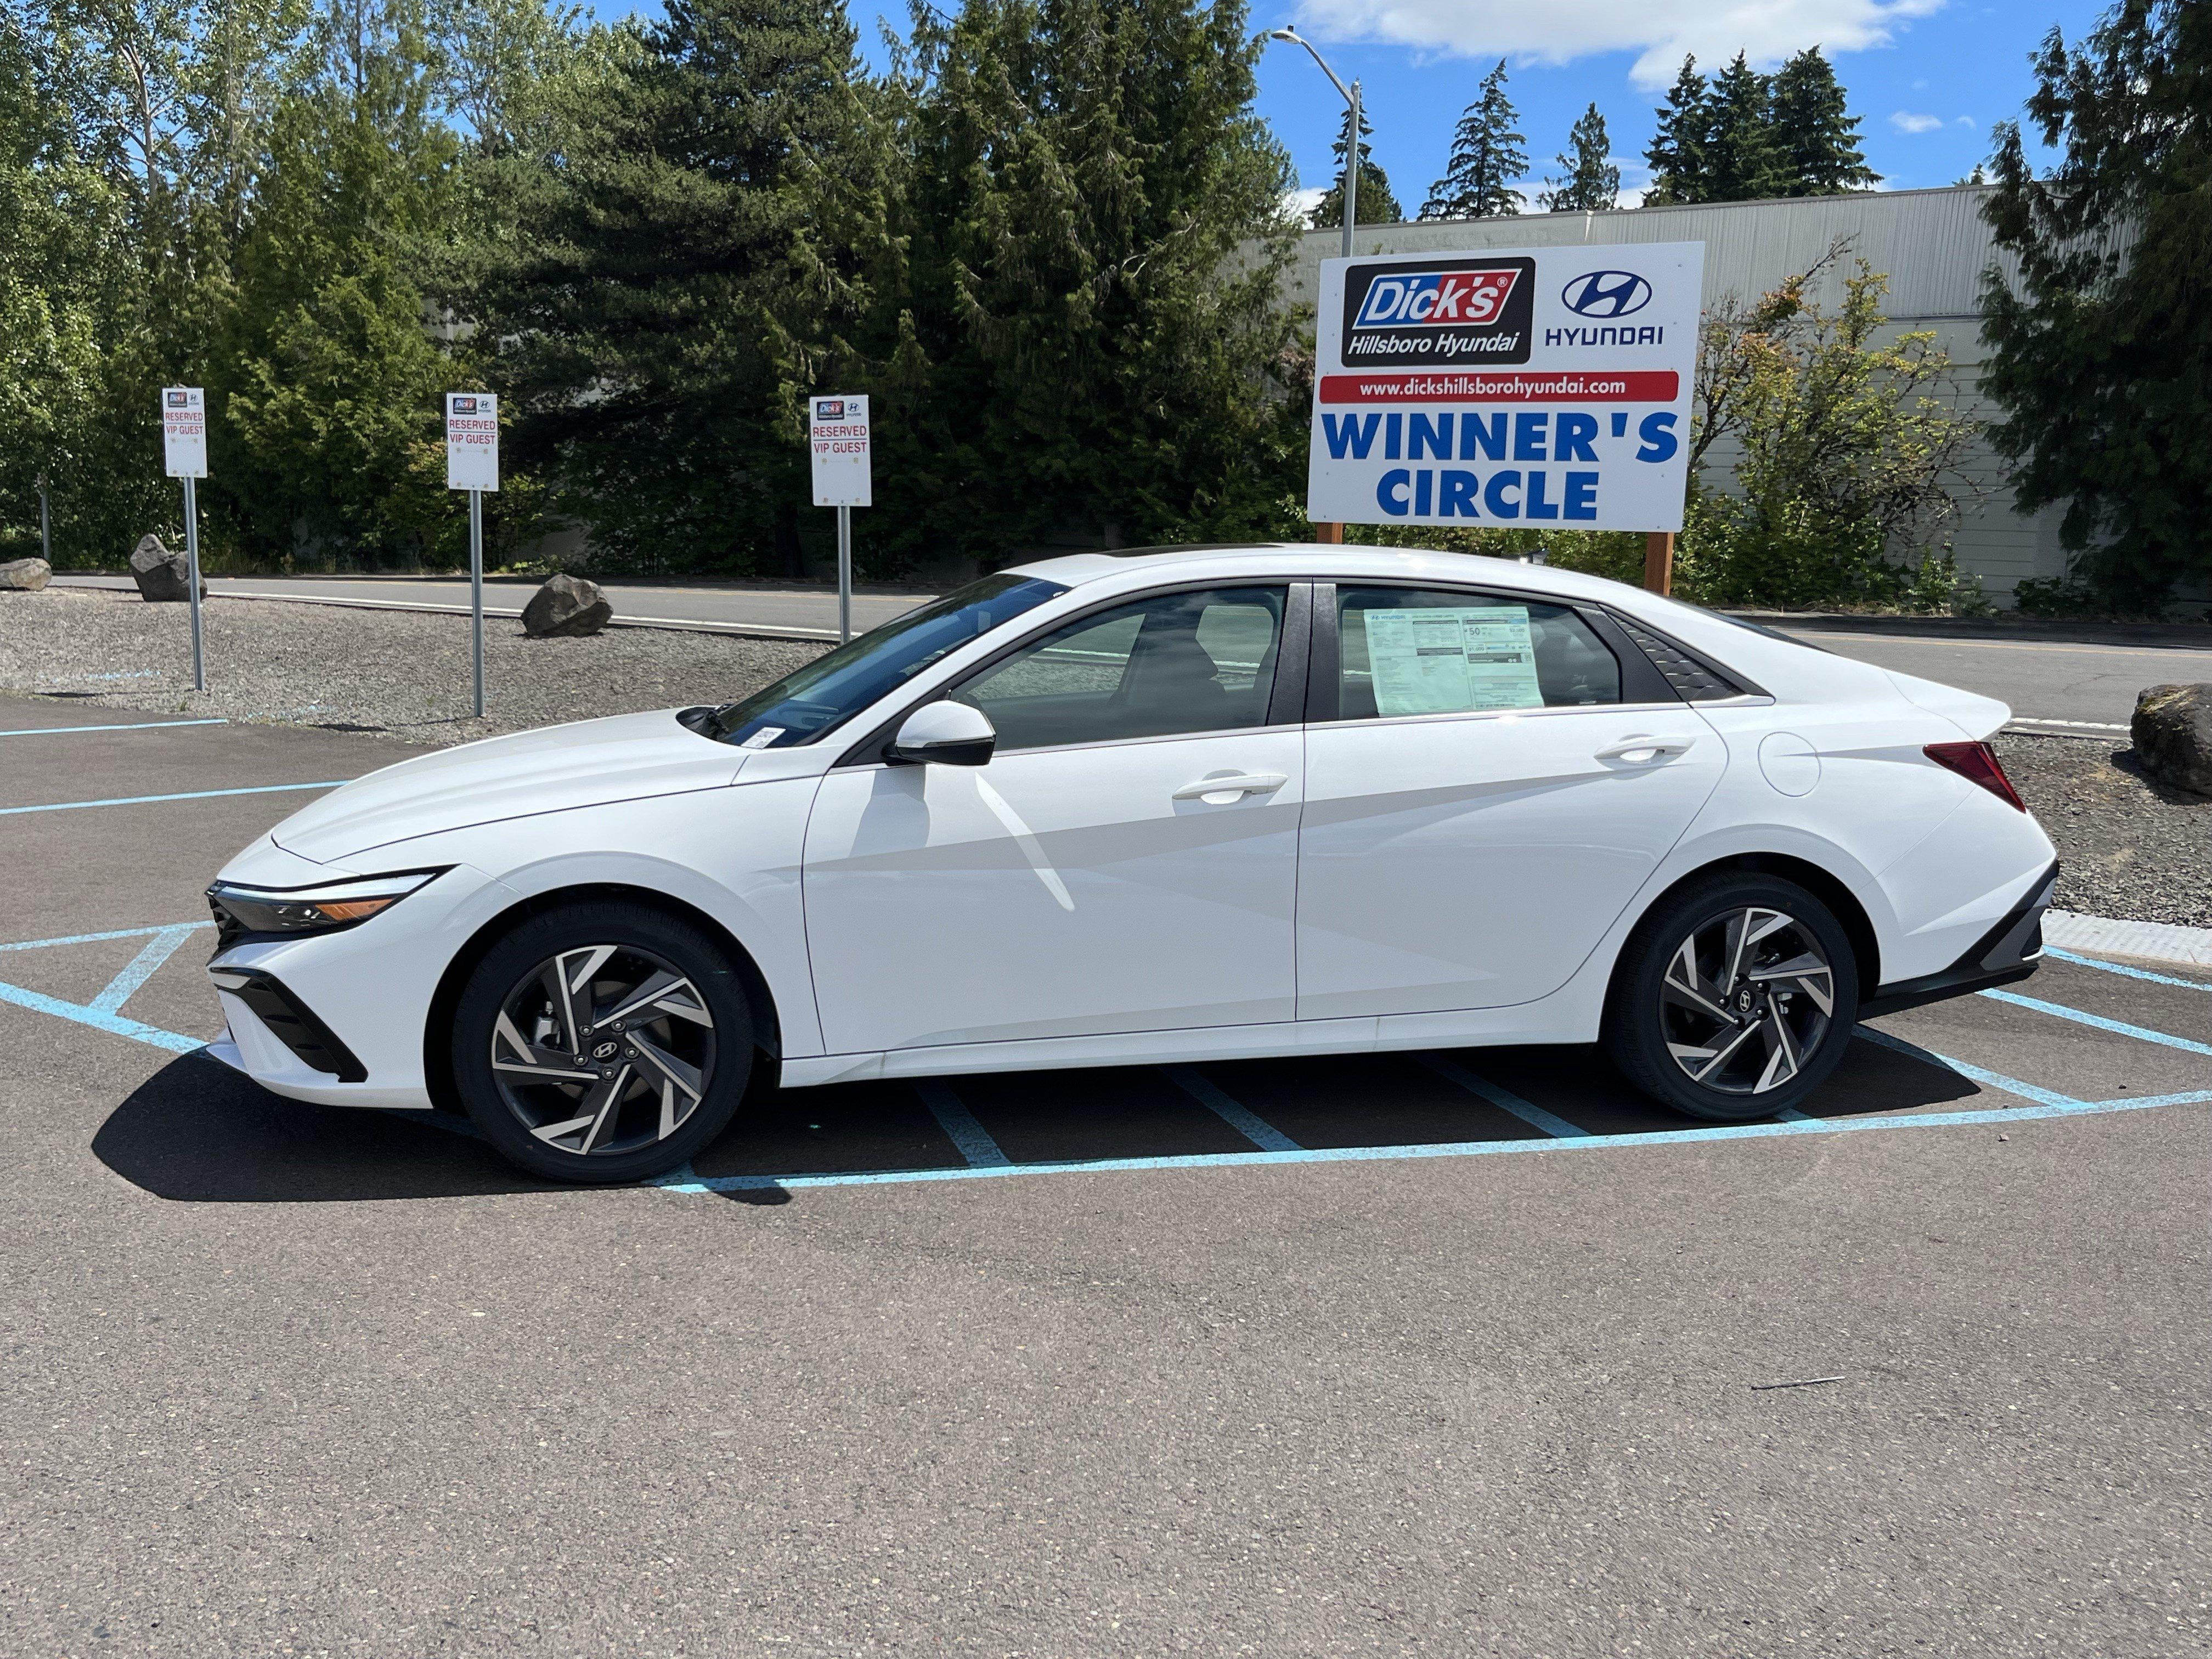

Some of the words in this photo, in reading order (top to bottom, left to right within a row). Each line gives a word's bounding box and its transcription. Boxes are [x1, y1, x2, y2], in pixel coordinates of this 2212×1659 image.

[1364, 276, 1499, 321] Dick's
[1545, 326, 1663, 347] HYUNDAI
[1347, 335, 1434, 355] Hillsboro
[1434, 331, 1521, 357] Hyundai
[1359, 377, 1626, 400] www.dickshillsborohyundai.com
[165, 412, 203, 421] RESERVED
[179, 426, 204, 435] GUEST
[449, 420, 495, 430] RESERVED
[813, 425, 867, 437] RESERVED
[450, 434, 464, 443] VIP
[466, 434, 495, 444] GUEST
[1321, 411, 1679, 463] WINNER'S
[814, 443, 830, 453] VIP
[832, 442, 867, 453] GUEST
[1376, 469, 1600, 521] CIRCLE
[1469, 627, 1481, 635] 50
